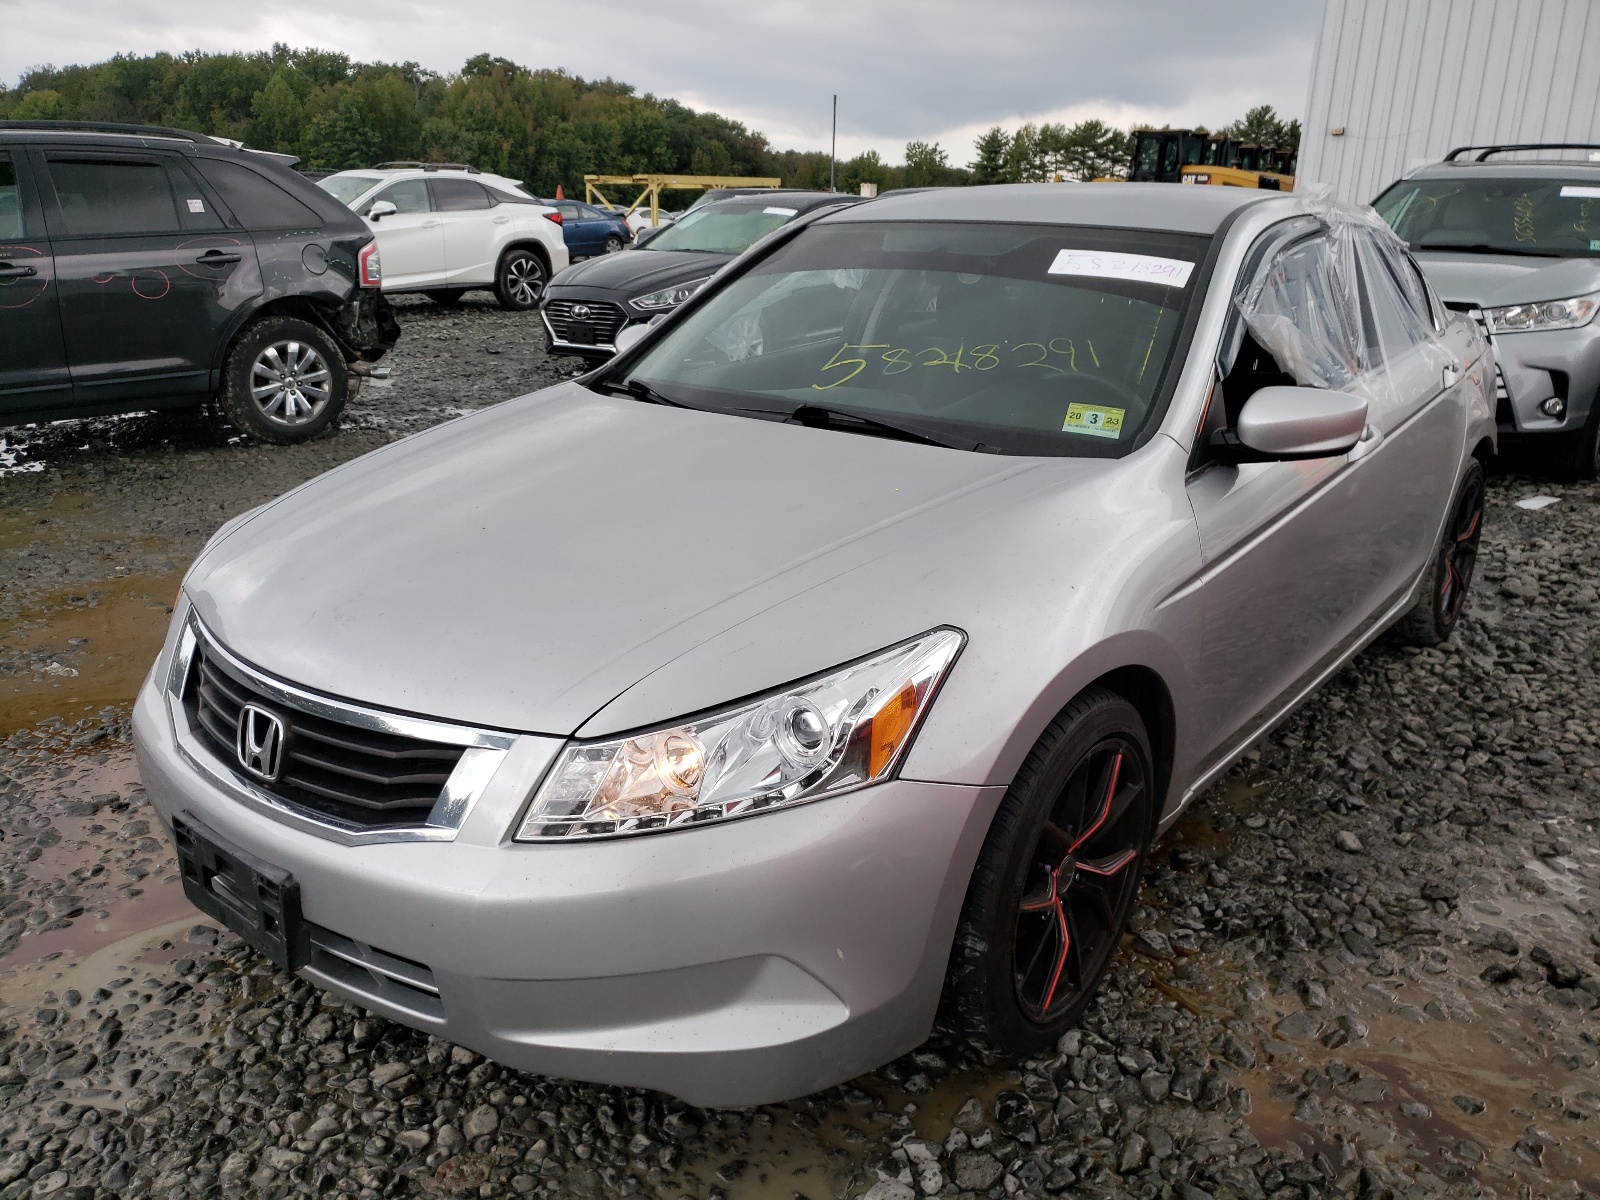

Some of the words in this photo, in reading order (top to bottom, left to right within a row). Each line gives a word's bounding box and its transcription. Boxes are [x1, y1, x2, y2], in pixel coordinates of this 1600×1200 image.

[1069, 411, 1082, 420] 20
[1089, 413, 1099, 425] 3
[1105, 417, 1120, 425] 23
